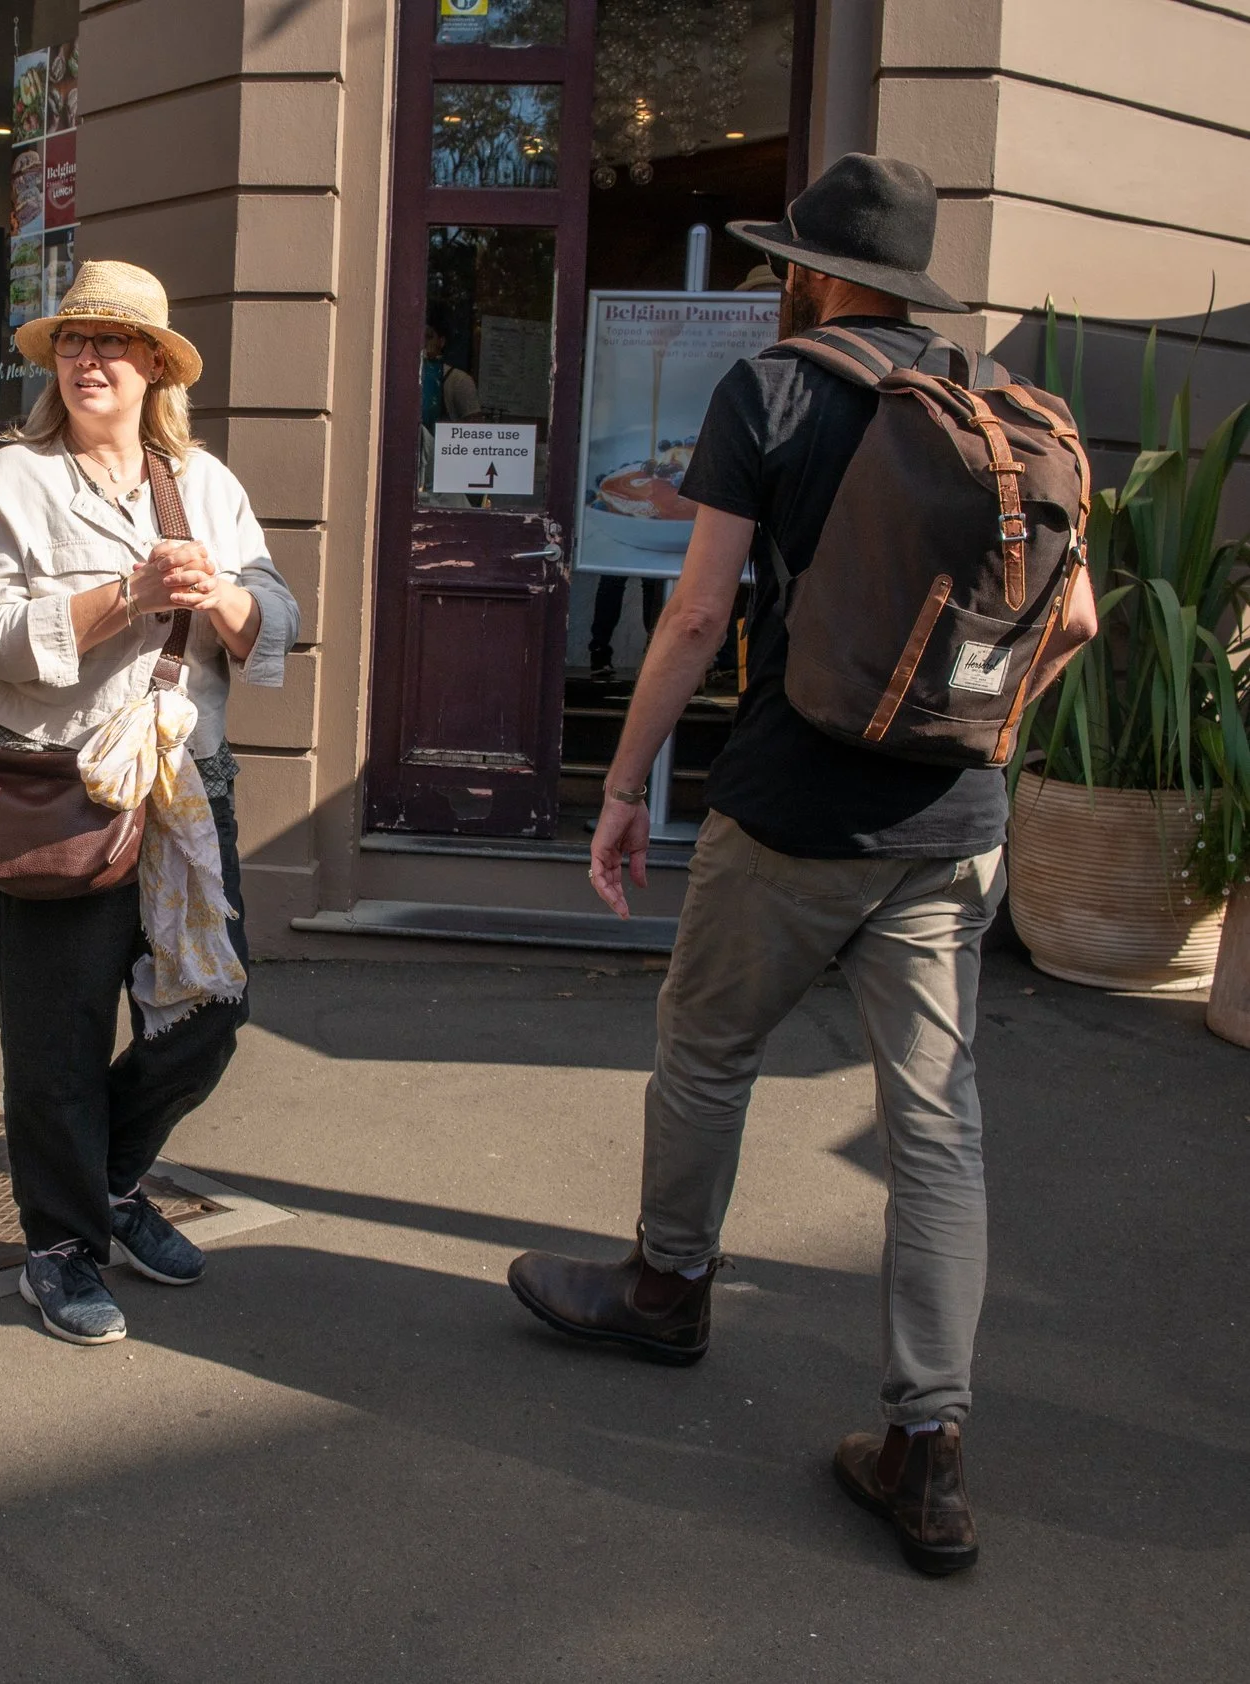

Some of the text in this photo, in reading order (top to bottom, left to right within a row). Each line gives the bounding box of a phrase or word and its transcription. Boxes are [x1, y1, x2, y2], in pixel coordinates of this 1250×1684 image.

[53, 186, 73, 199] LUNCH
[606, 304, 780, 322] Belgian Pancakes
[607, 326, 642, 337] Topped
[710, 339, 747, 349] perfect
[706, 351, 726, 359] day
[6, 363, 27, 380] New
[451, 427, 520, 440] Please use
[441, 444, 529, 457] side entrance
[964, 652, 1000, 671] Herschel
